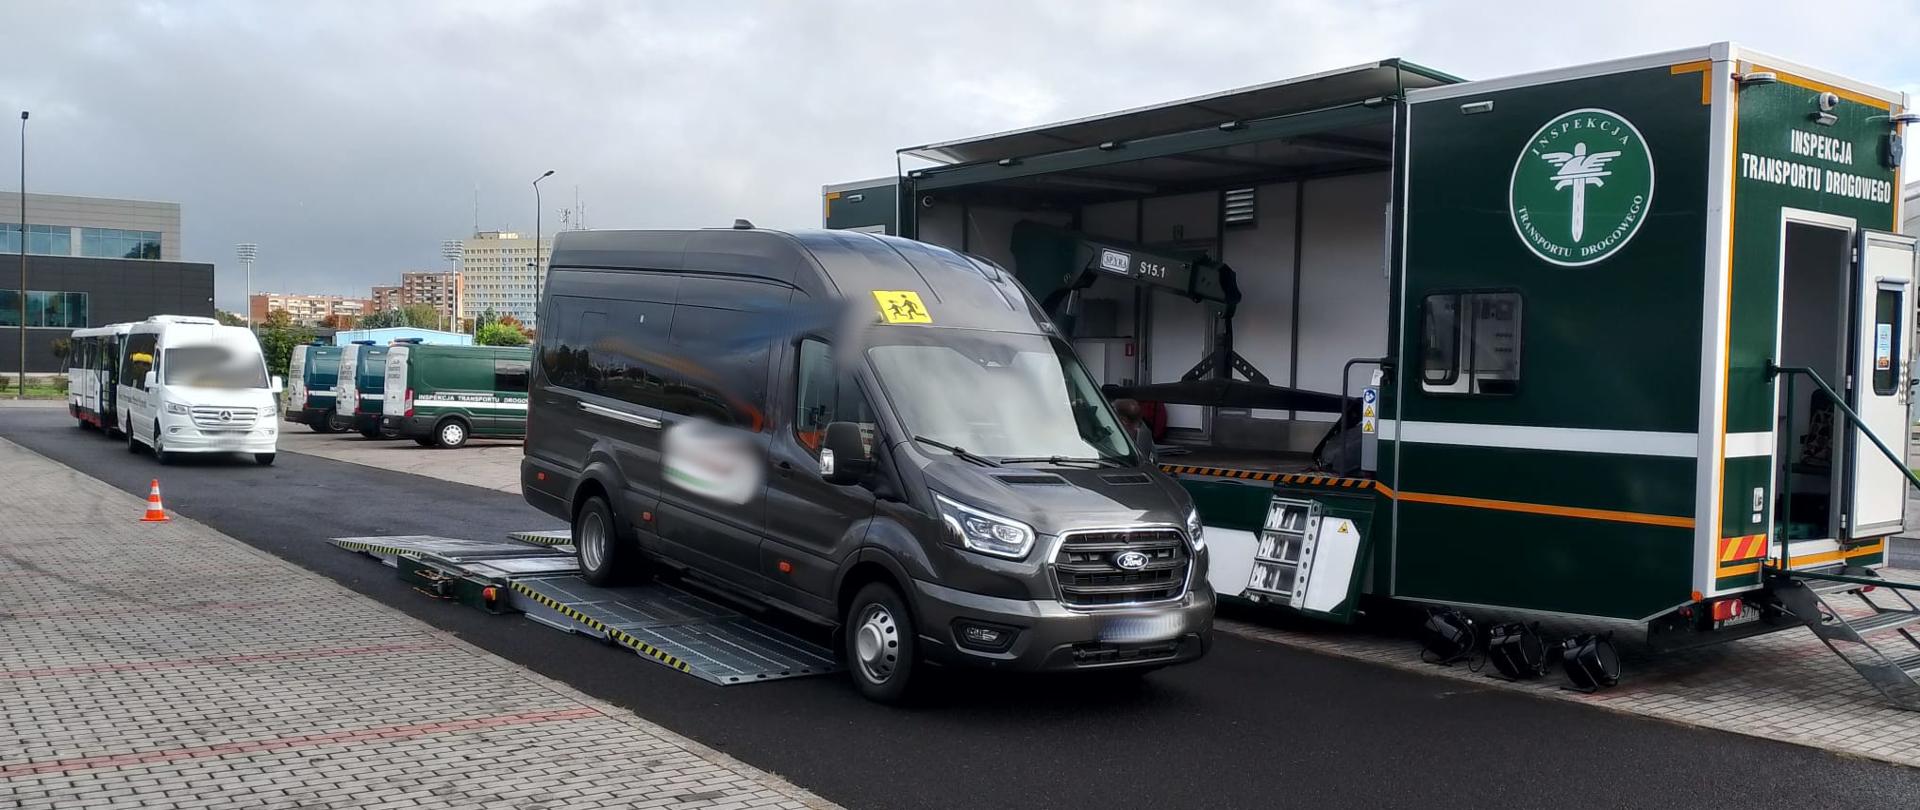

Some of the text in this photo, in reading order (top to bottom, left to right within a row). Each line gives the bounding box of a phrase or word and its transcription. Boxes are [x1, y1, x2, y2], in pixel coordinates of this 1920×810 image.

[1532, 118, 1629, 156] INSPEKCJA
[1790, 129, 1853, 165] INSPEKCJA
[1741, 152, 1891, 204] TRANSPORTU DROGOWEGO
[1518, 195, 1643, 257] TRANSPORTU DROGOWEGO
[1139, 261, 1165, 278] S15.1
[458, 395, 500, 403] TRANSPORTU
